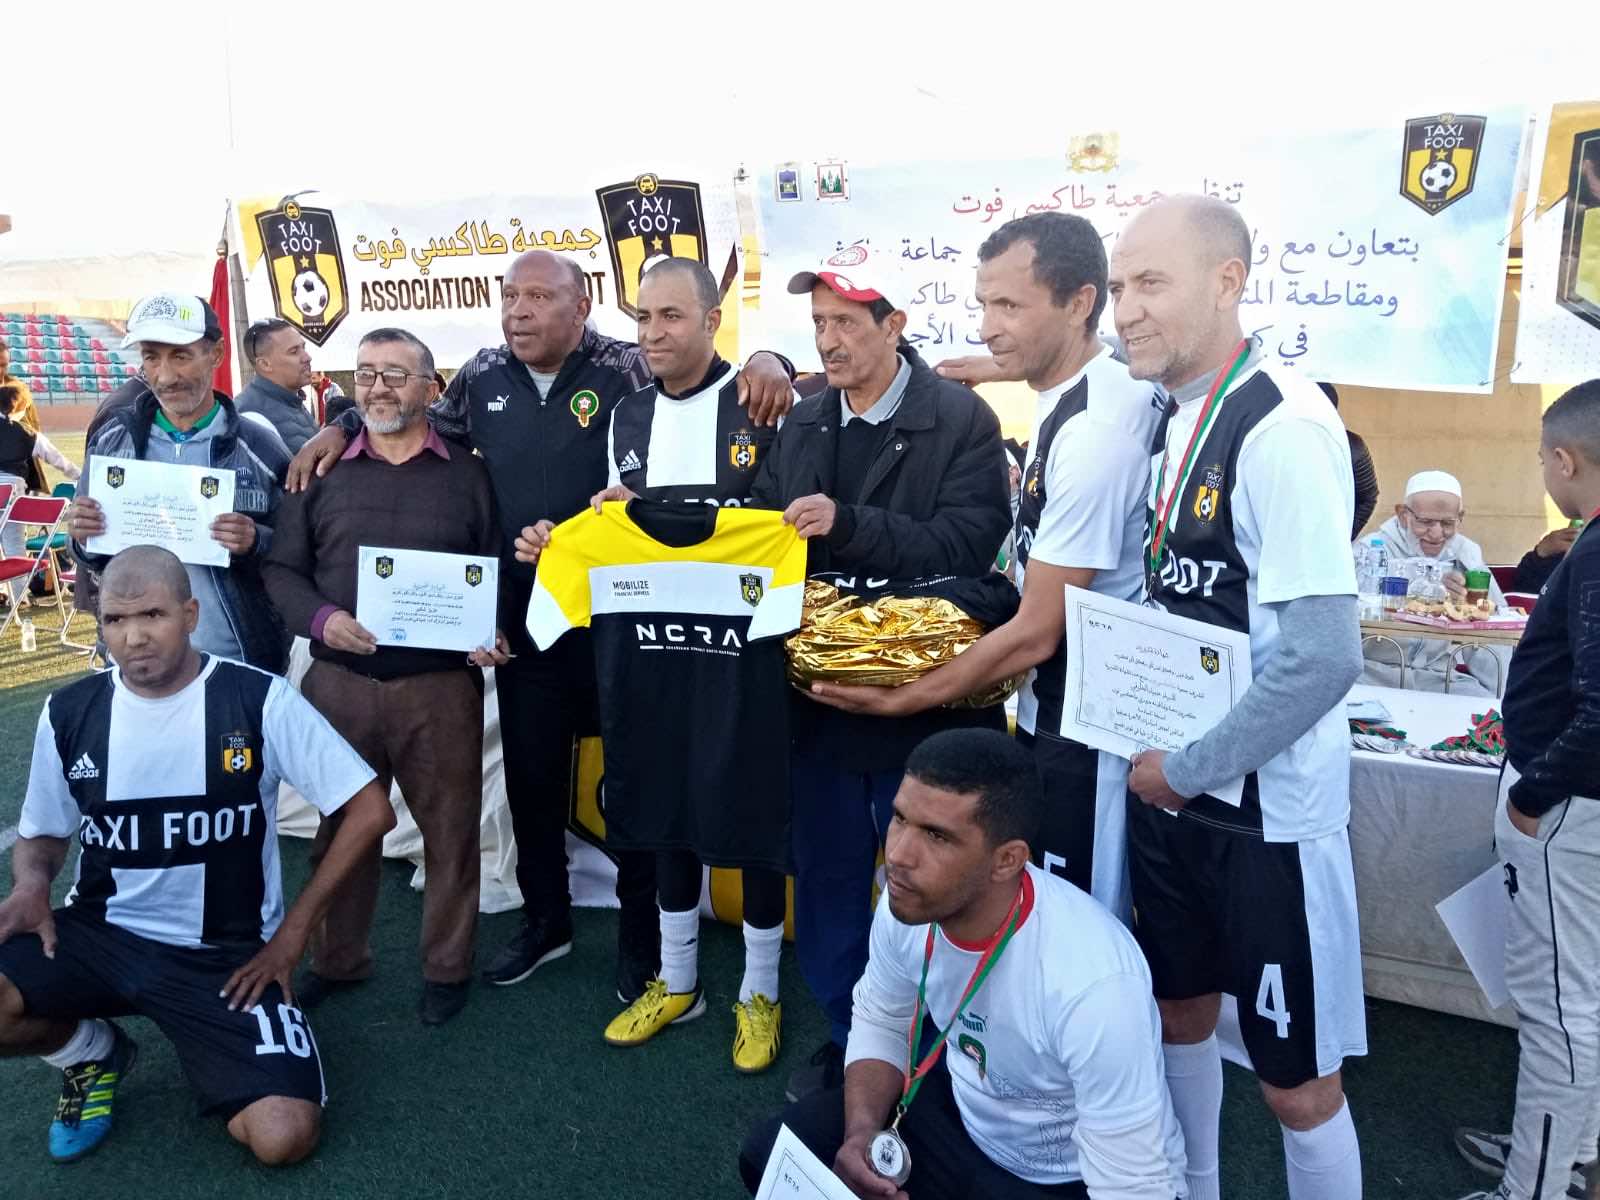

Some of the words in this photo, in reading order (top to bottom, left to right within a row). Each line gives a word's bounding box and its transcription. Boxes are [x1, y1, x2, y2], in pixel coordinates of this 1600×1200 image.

[1423, 124, 1464, 137] TAXI
[1424, 137, 1465, 149] FOOT
[627, 196, 672, 217] TAXI
[952, 187, 1004, 223] فوت
[278, 221, 314, 238] TAXI
[627, 215, 681, 237] FOOT
[280, 236, 323, 256] FOOT
[352, 228, 407, 269] فوت
[411, 219, 509, 276] طاكسي
[900, 236, 962, 263] جماعة
[1279, 240, 1316, 274] مع
[1327, 228, 1419, 265] بتعاون
[360, 275, 492, 313] ASSOCIATION
[1286, 279, 1399, 317] ومقاطعة
[1277, 324, 1309, 367] في
[734, 434, 751, 442] TAXI
[619, 463, 642, 473] adidas
[635, 623, 743, 648] NCRA
[68, 768, 100, 780] adidas
[163, 803, 258, 849] FOOT
[1255, 963, 1291, 1038] 4
[249, 1002, 311, 1058] 16
